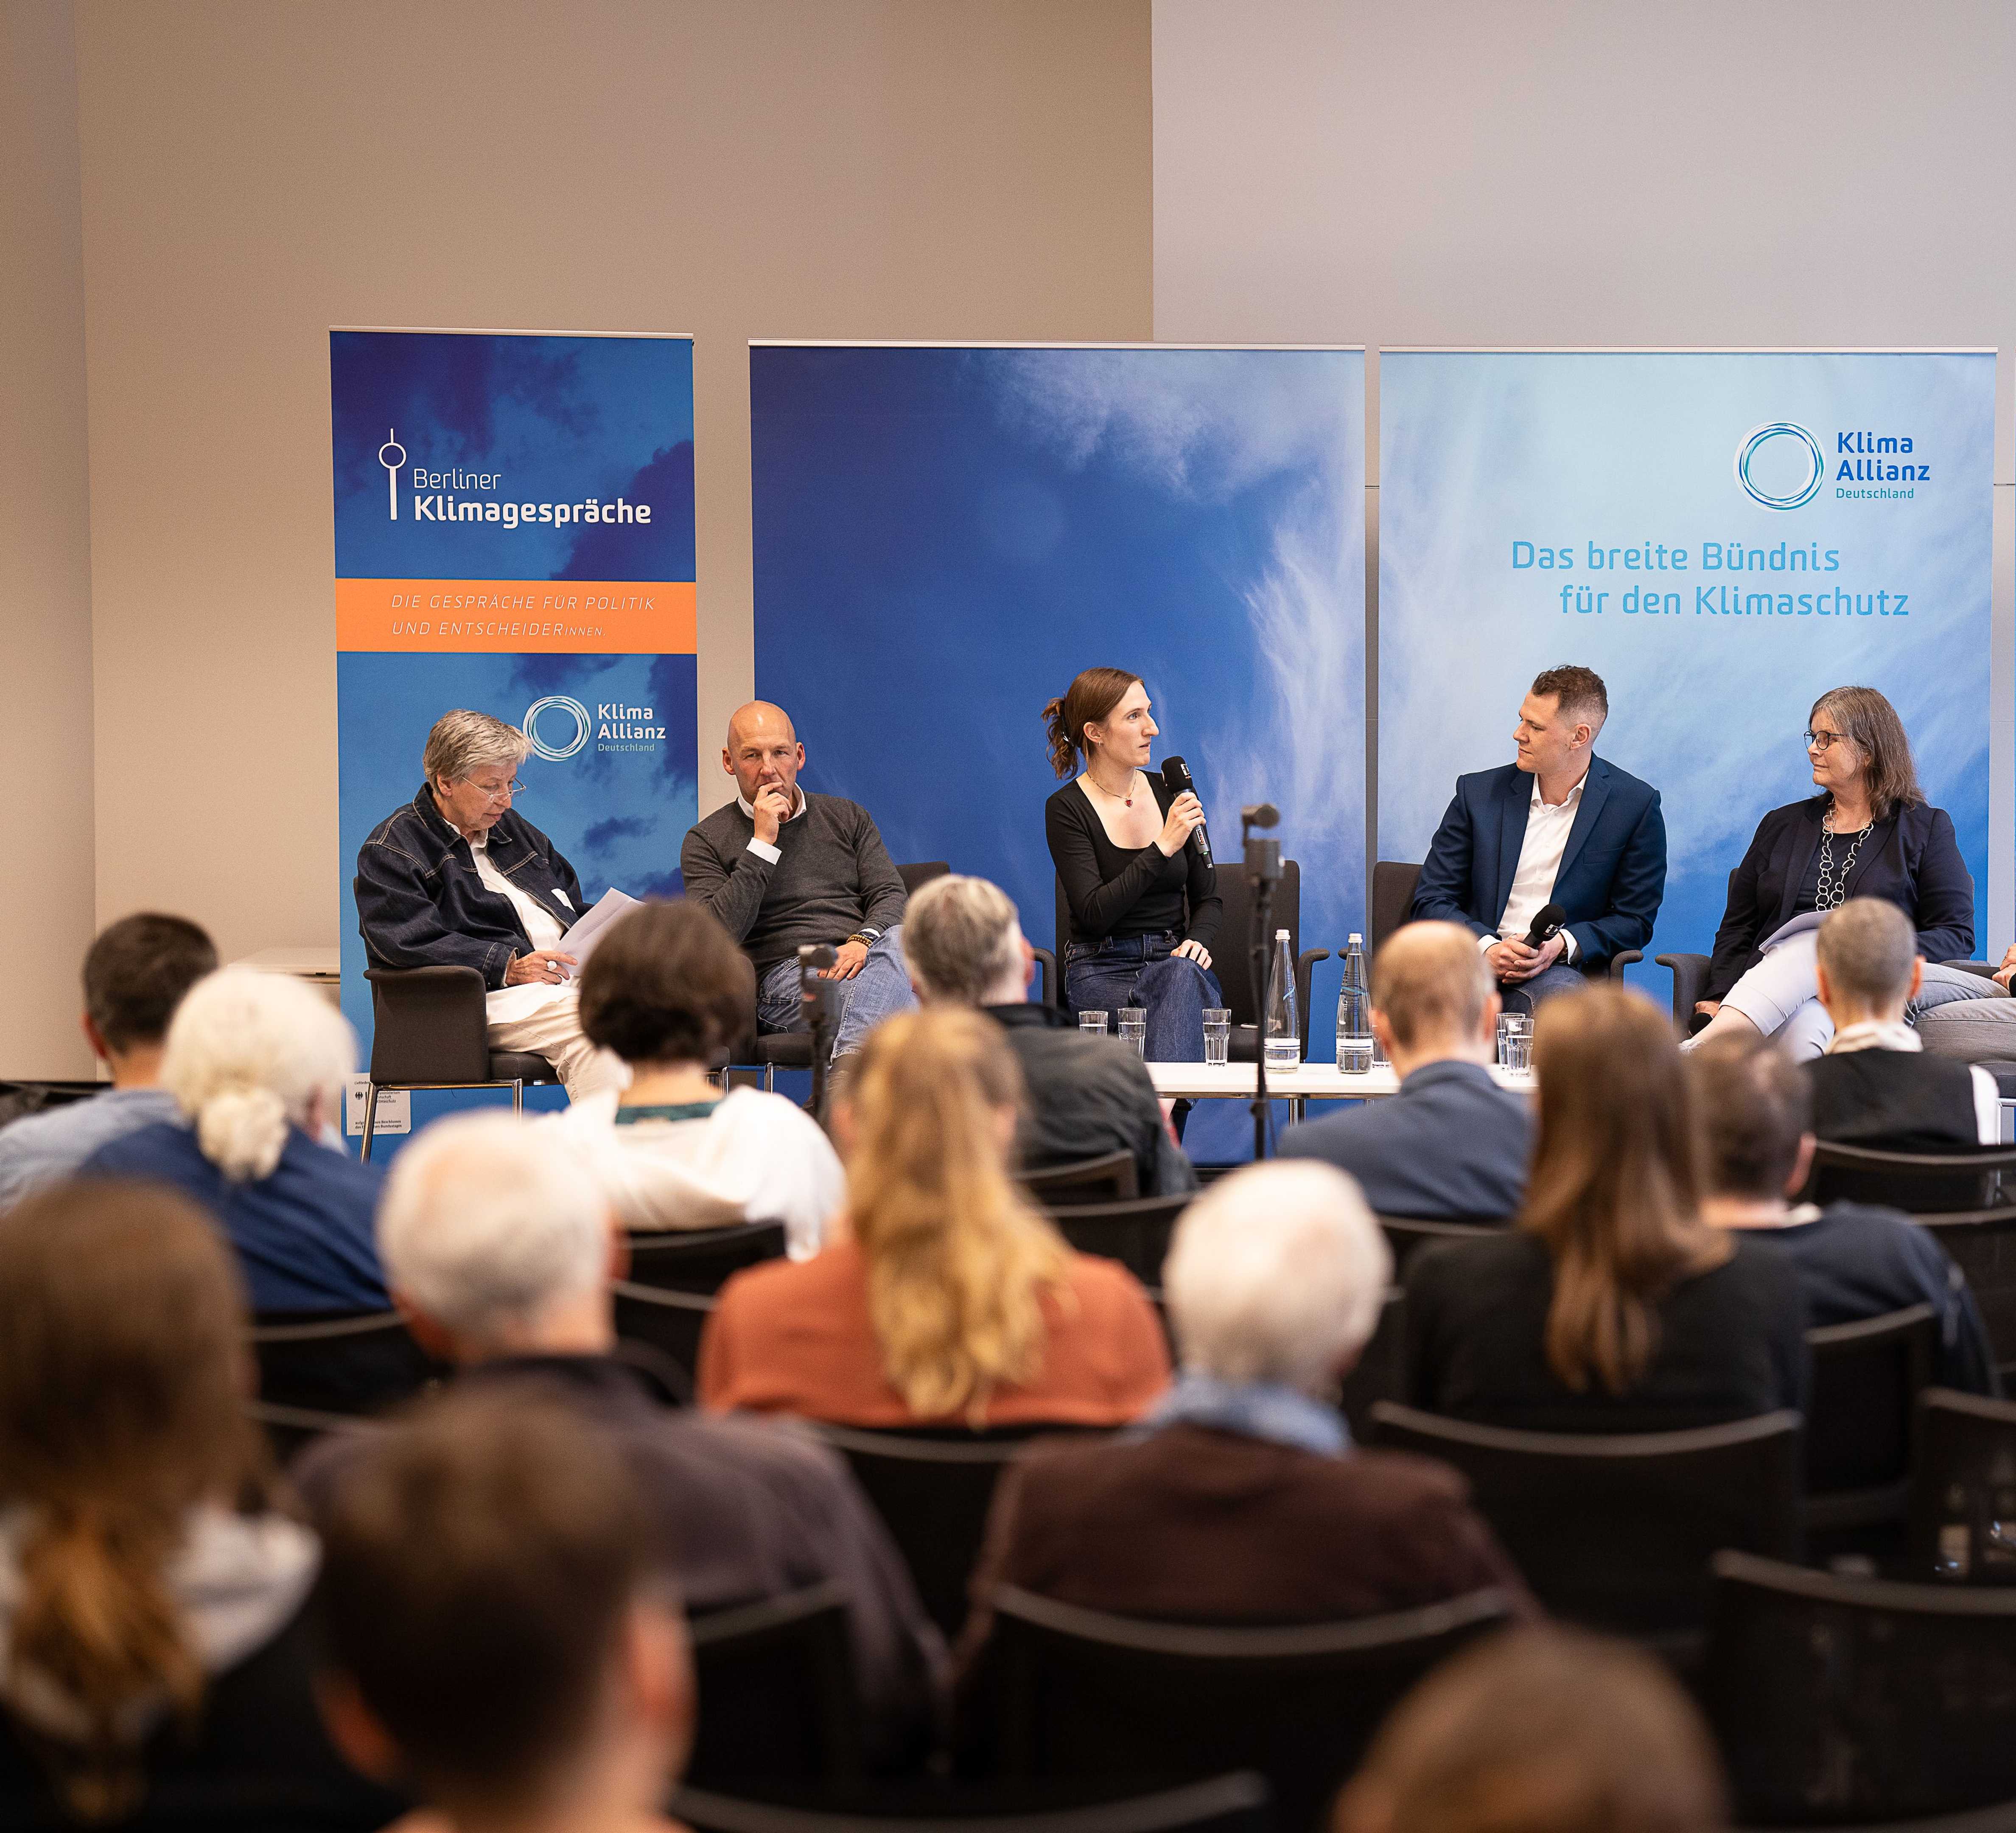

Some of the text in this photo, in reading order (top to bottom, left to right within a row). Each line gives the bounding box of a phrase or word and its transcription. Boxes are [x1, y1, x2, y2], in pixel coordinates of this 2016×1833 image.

[1837, 431, 1913, 454] Klima
[414, 468, 501, 490] Berliner
[1836, 459, 1930, 482] Allianz
[1836, 488, 1914, 499] Deutschland
[414, 495, 651, 529] Klimagespräche
[1513, 541, 1839, 572] Das breite Bündnis
[392, 594, 655, 610] DIE GESPRÄCHE FÜR POLITIK
[1560, 584, 1909, 616] für den Klimaschutz
[392, 622, 431, 635] UND
[598, 703, 653, 720] Klima
[598, 723, 666, 740] Allianz
[598, 743, 655, 752] Deutschland
